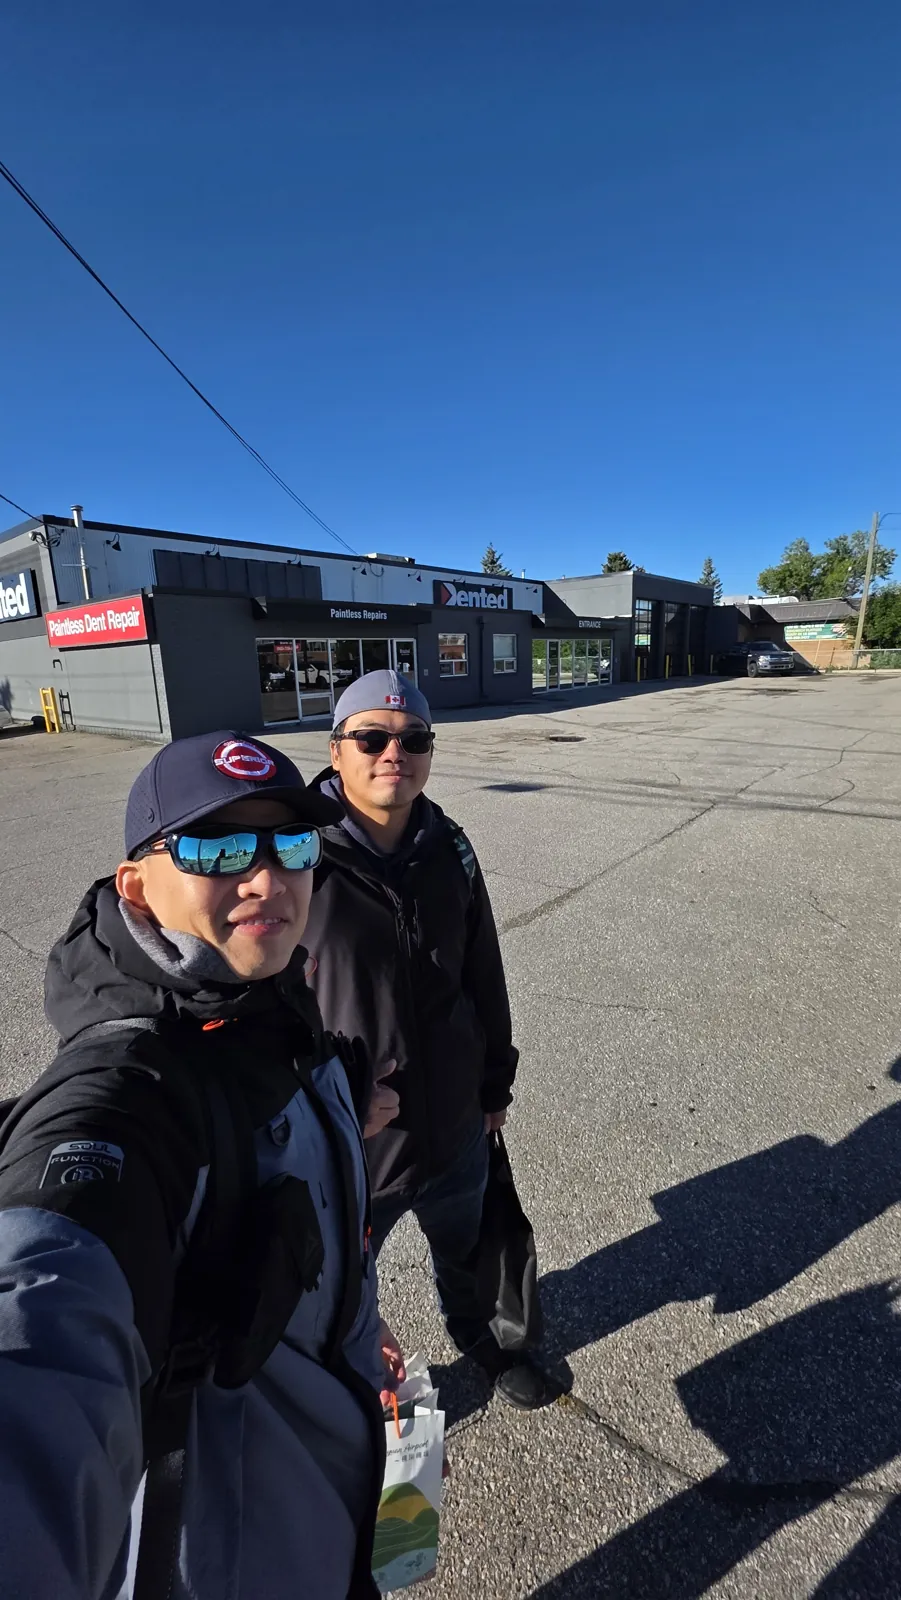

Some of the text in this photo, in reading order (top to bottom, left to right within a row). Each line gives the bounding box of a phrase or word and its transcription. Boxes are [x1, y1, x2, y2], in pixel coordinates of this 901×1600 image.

[330, 608, 388, 622] Paintless Repairs
[49, 606, 140, 638] Paintless Dent Repair
[578, 620, 602, 629] ENTRANCE
[68, 1142, 111, 1154] SOUL
[51, 1154, 120, 1169] FUNCTION
[403, 1440, 429, 1453] Airport
